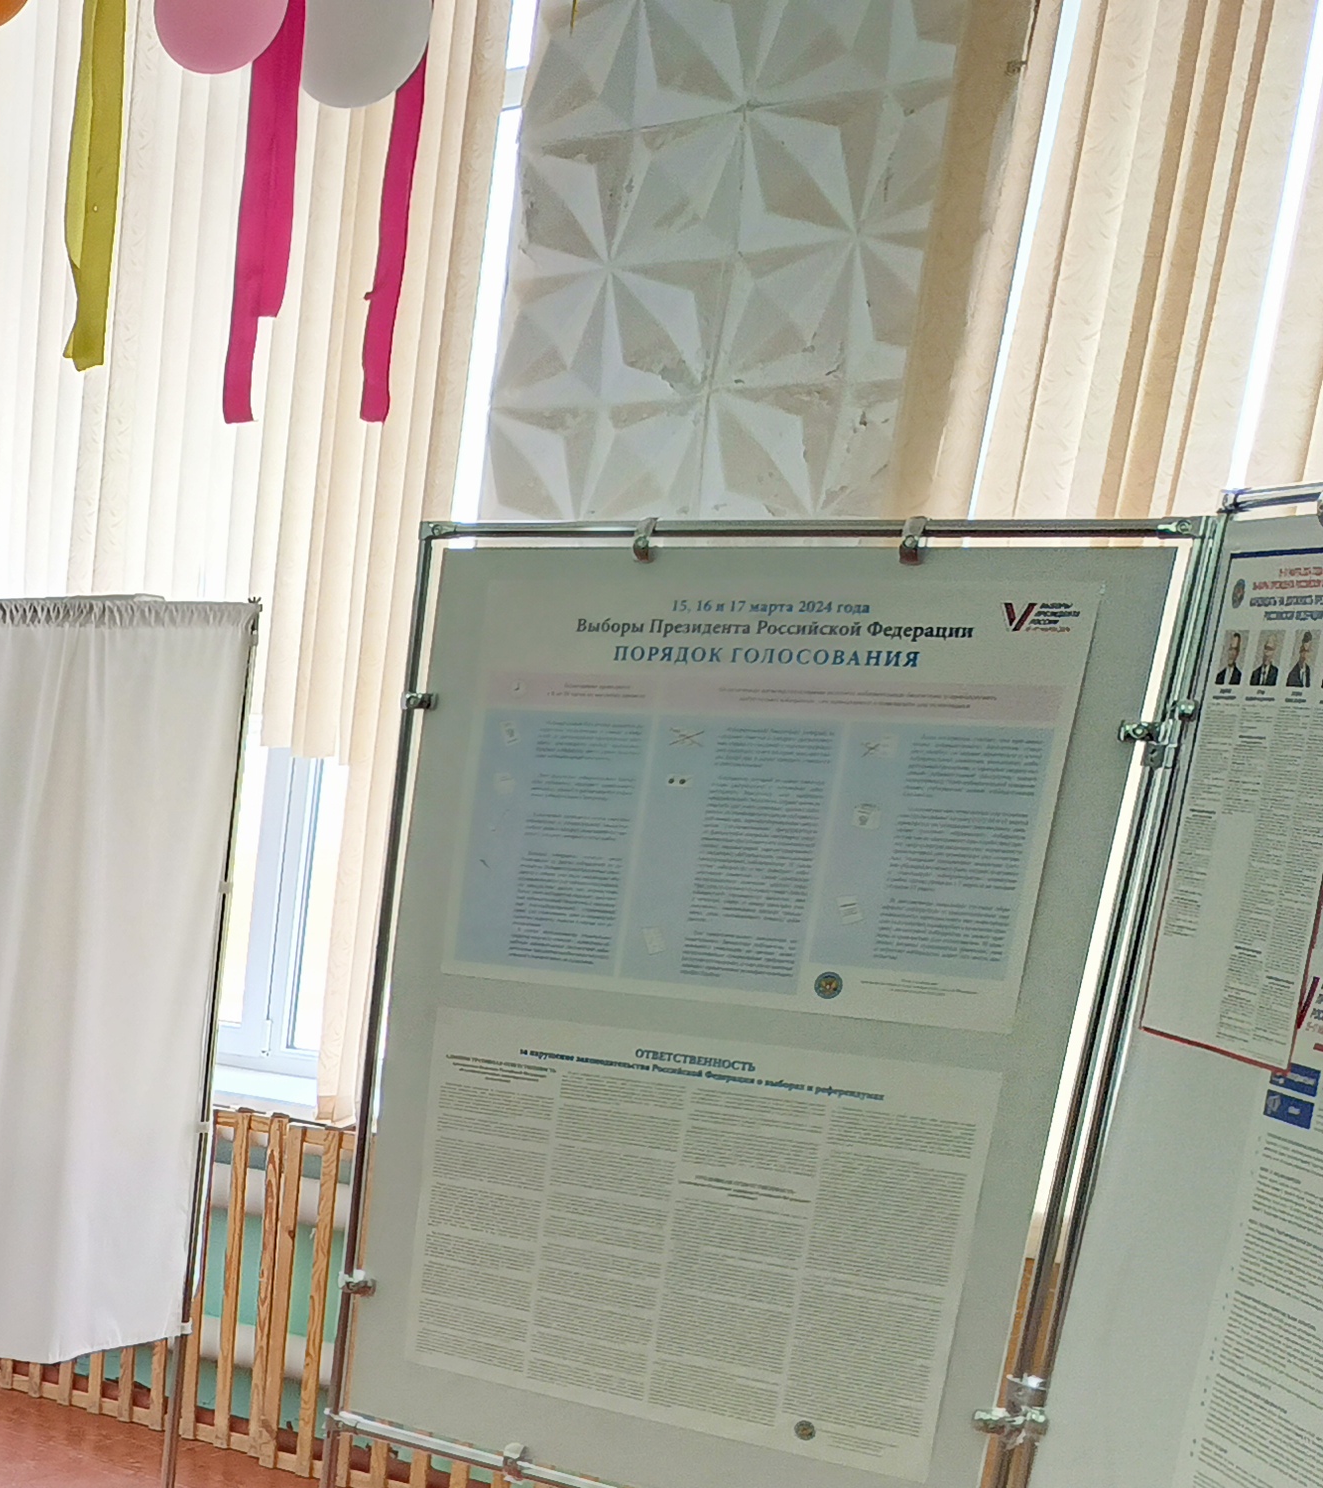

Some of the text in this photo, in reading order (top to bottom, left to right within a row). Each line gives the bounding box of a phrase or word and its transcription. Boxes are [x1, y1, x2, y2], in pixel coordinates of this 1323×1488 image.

[672, 600, 870, 616] 15, 16 и 17 марта 2024 года
[576, 618, 975, 642] Выборы Президента Российской Федерации
[613, 645, 920, 668] ПОРЯДОК ГОЛОСОВАНИЯ
[635, 1048, 756, 1072] ОТВЕТСТВЕННОСТЬ
[651, 1064, 703, 1078] Российской
